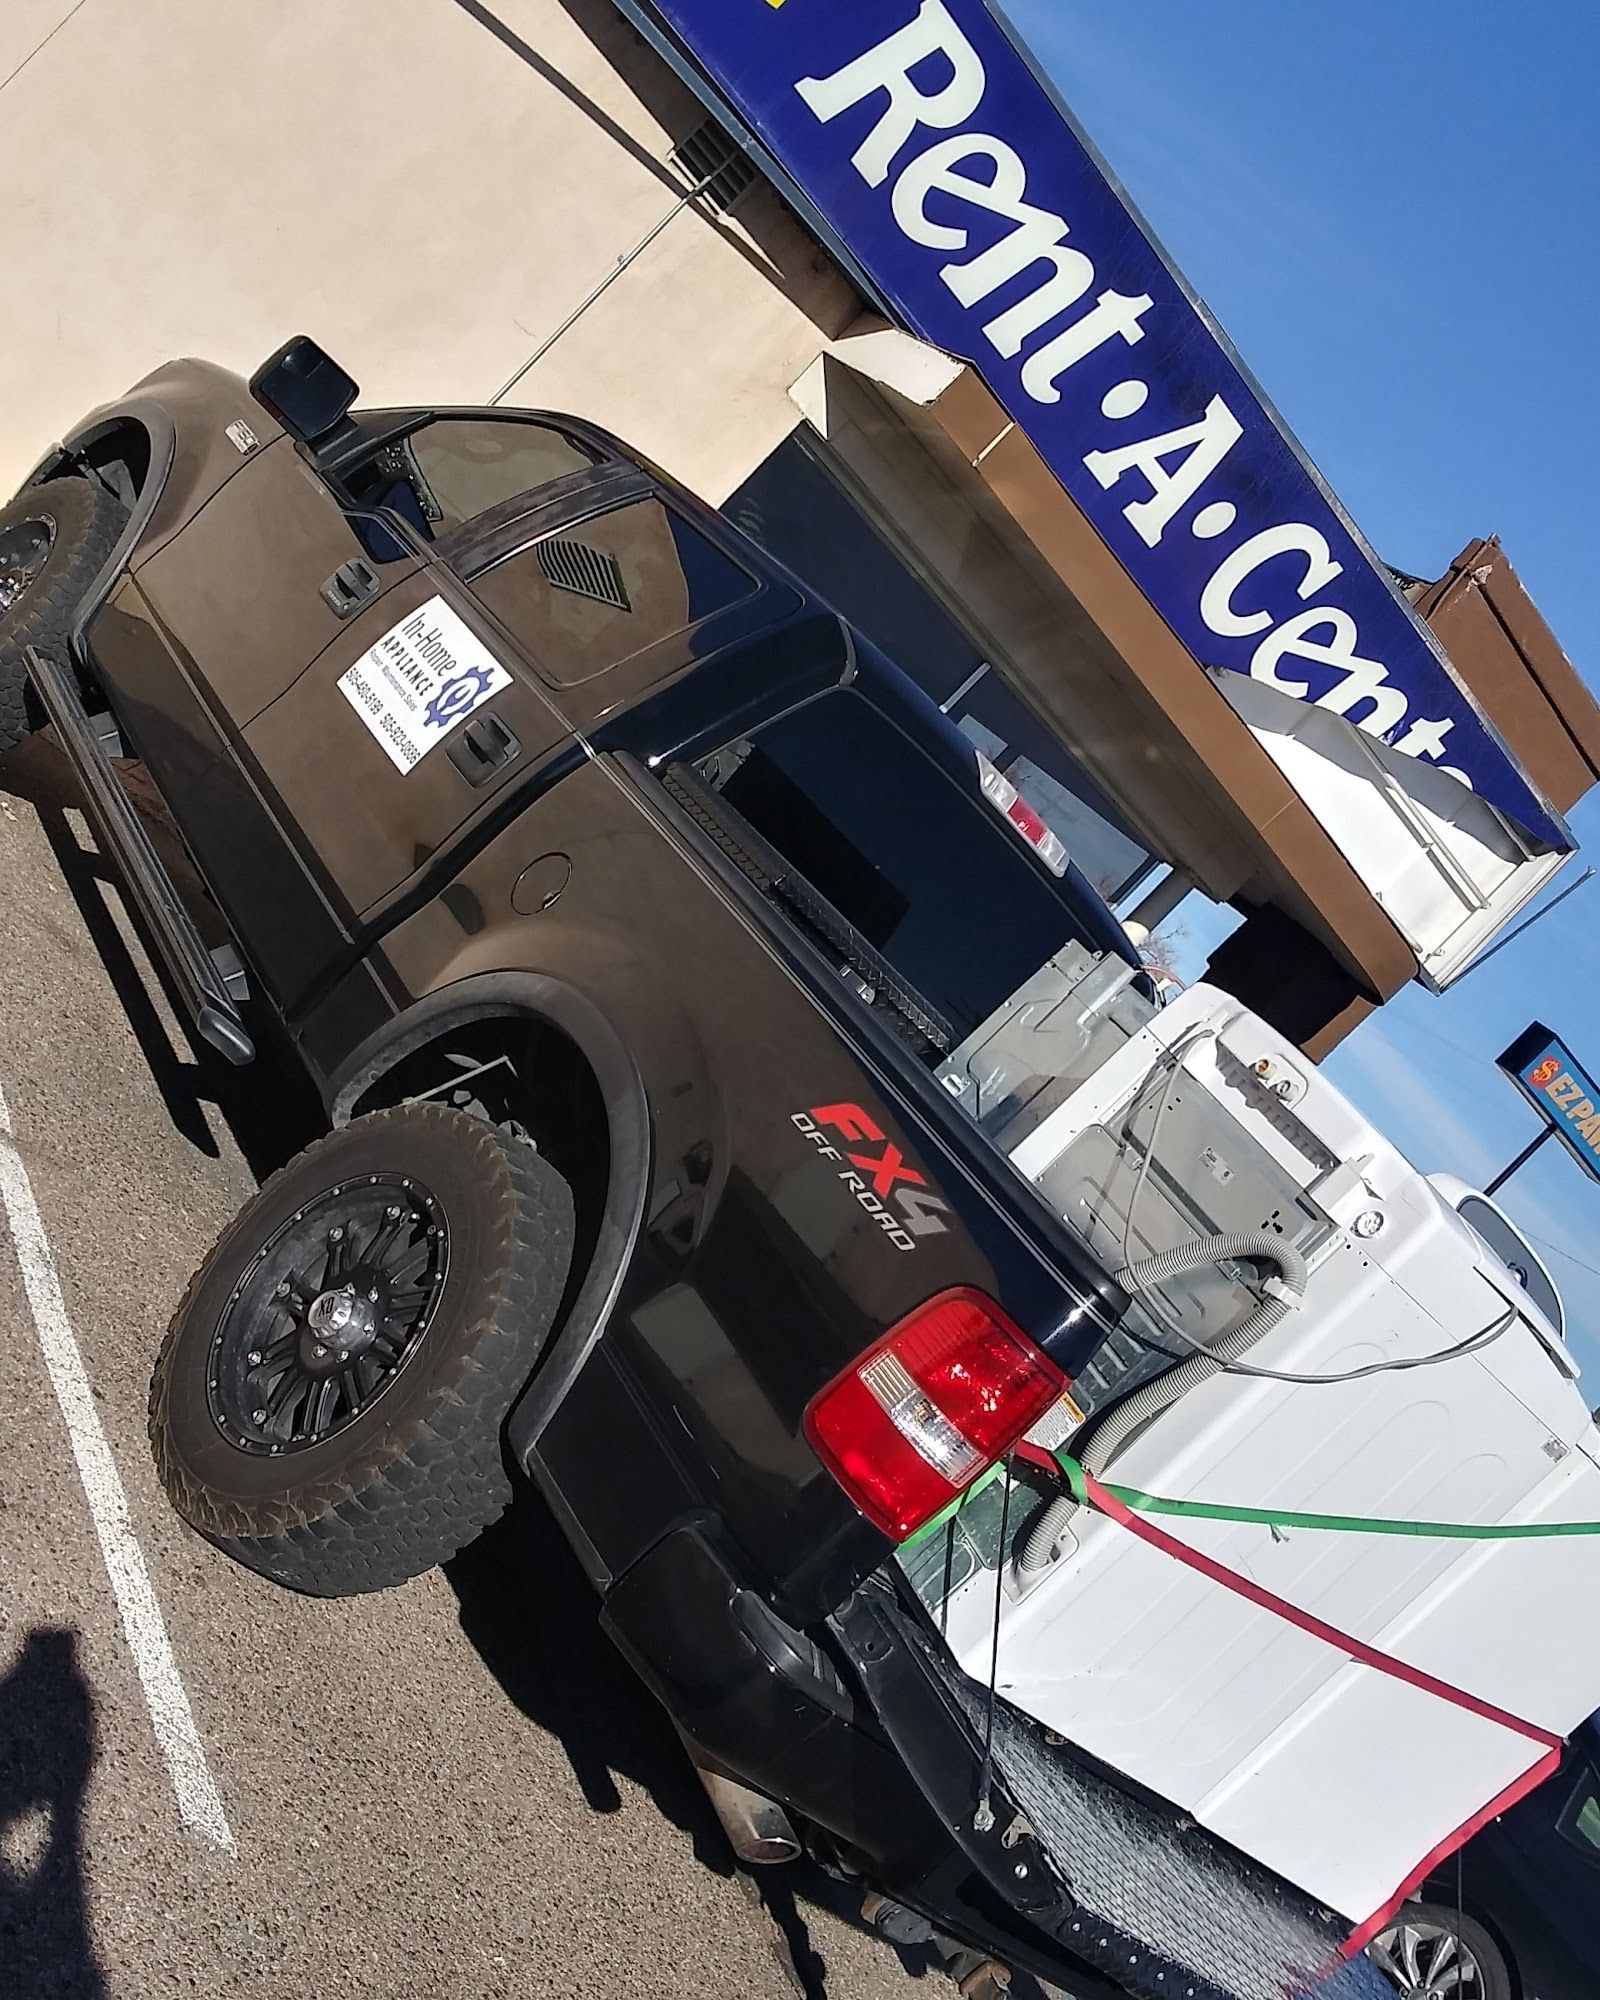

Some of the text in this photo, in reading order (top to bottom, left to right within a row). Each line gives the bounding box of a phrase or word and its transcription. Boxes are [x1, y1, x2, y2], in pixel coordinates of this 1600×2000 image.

[381, 635, 434, 697] APPLIANCE
[402, 612, 457, 677] In-Home
[790, 1113, 916, 1251] OFF ROAD
[810, 1103, 952, 1235] FX4
